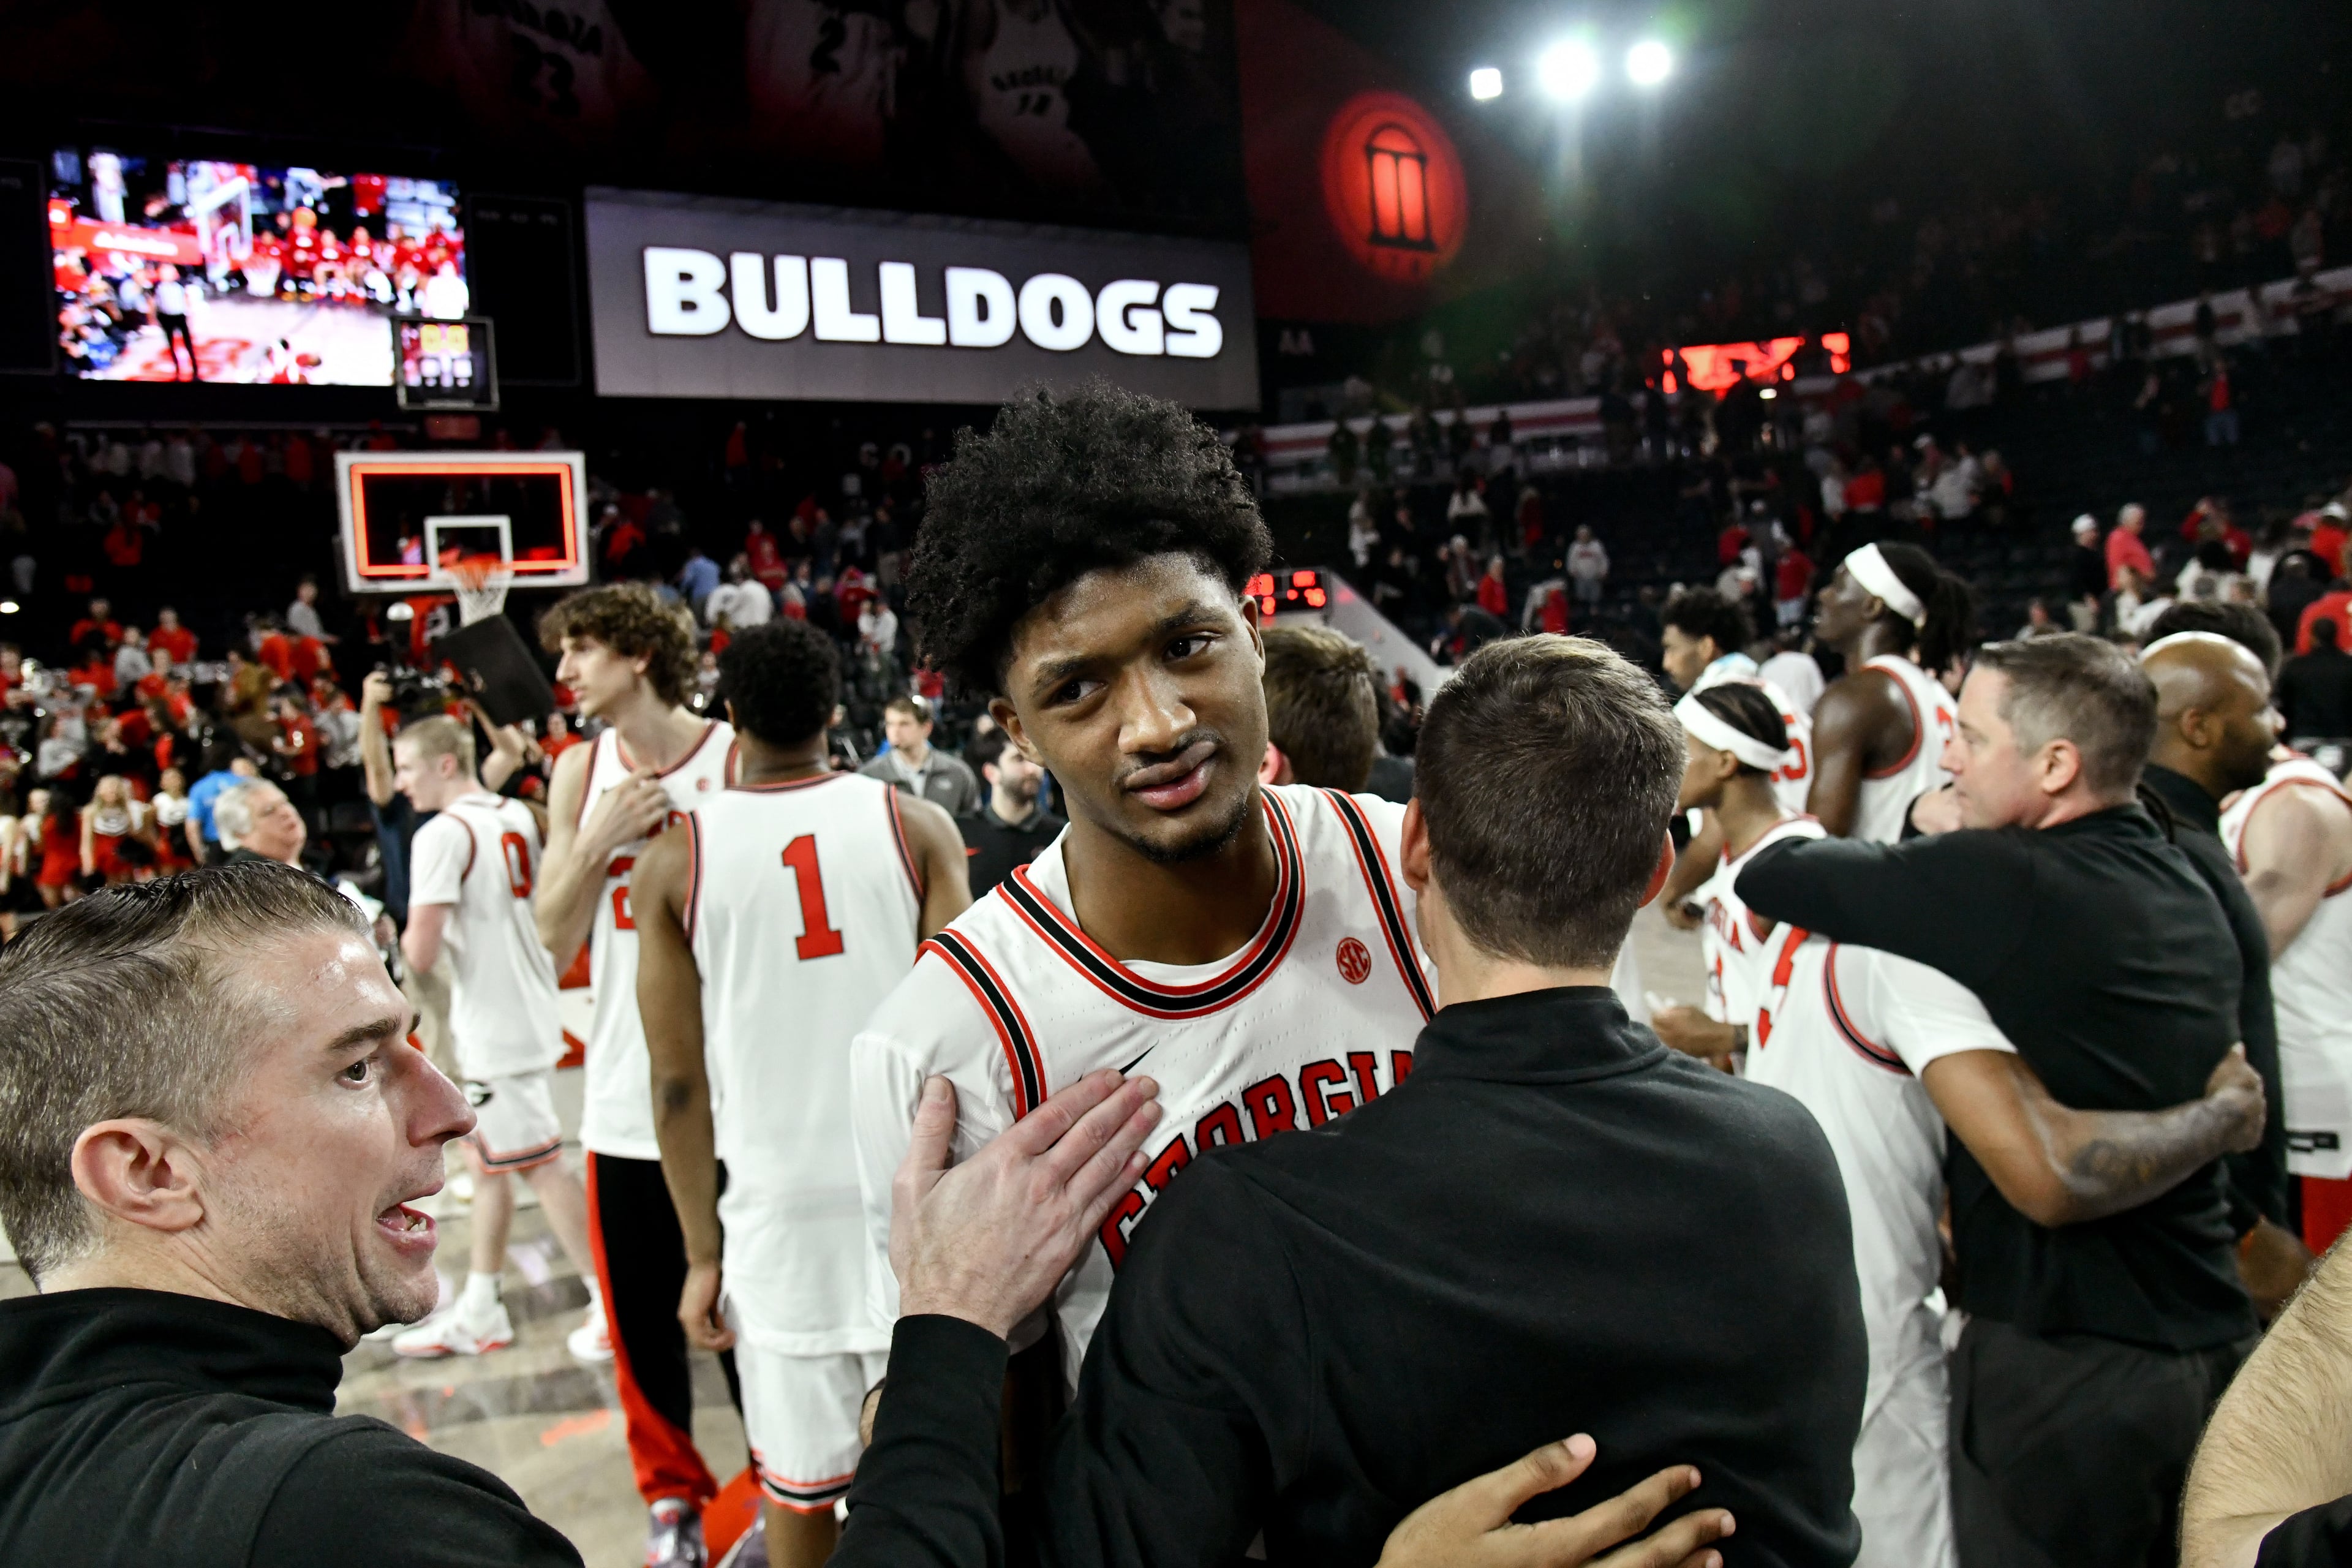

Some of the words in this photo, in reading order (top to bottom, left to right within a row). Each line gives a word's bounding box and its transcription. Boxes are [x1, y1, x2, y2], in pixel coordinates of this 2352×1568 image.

[643, 246, 1224, 358] BULLDOGS
[501, 831, 532, 899] 0
[782, 834, 845, 962] 1
[1338, 940, 1370, 982] SEC
